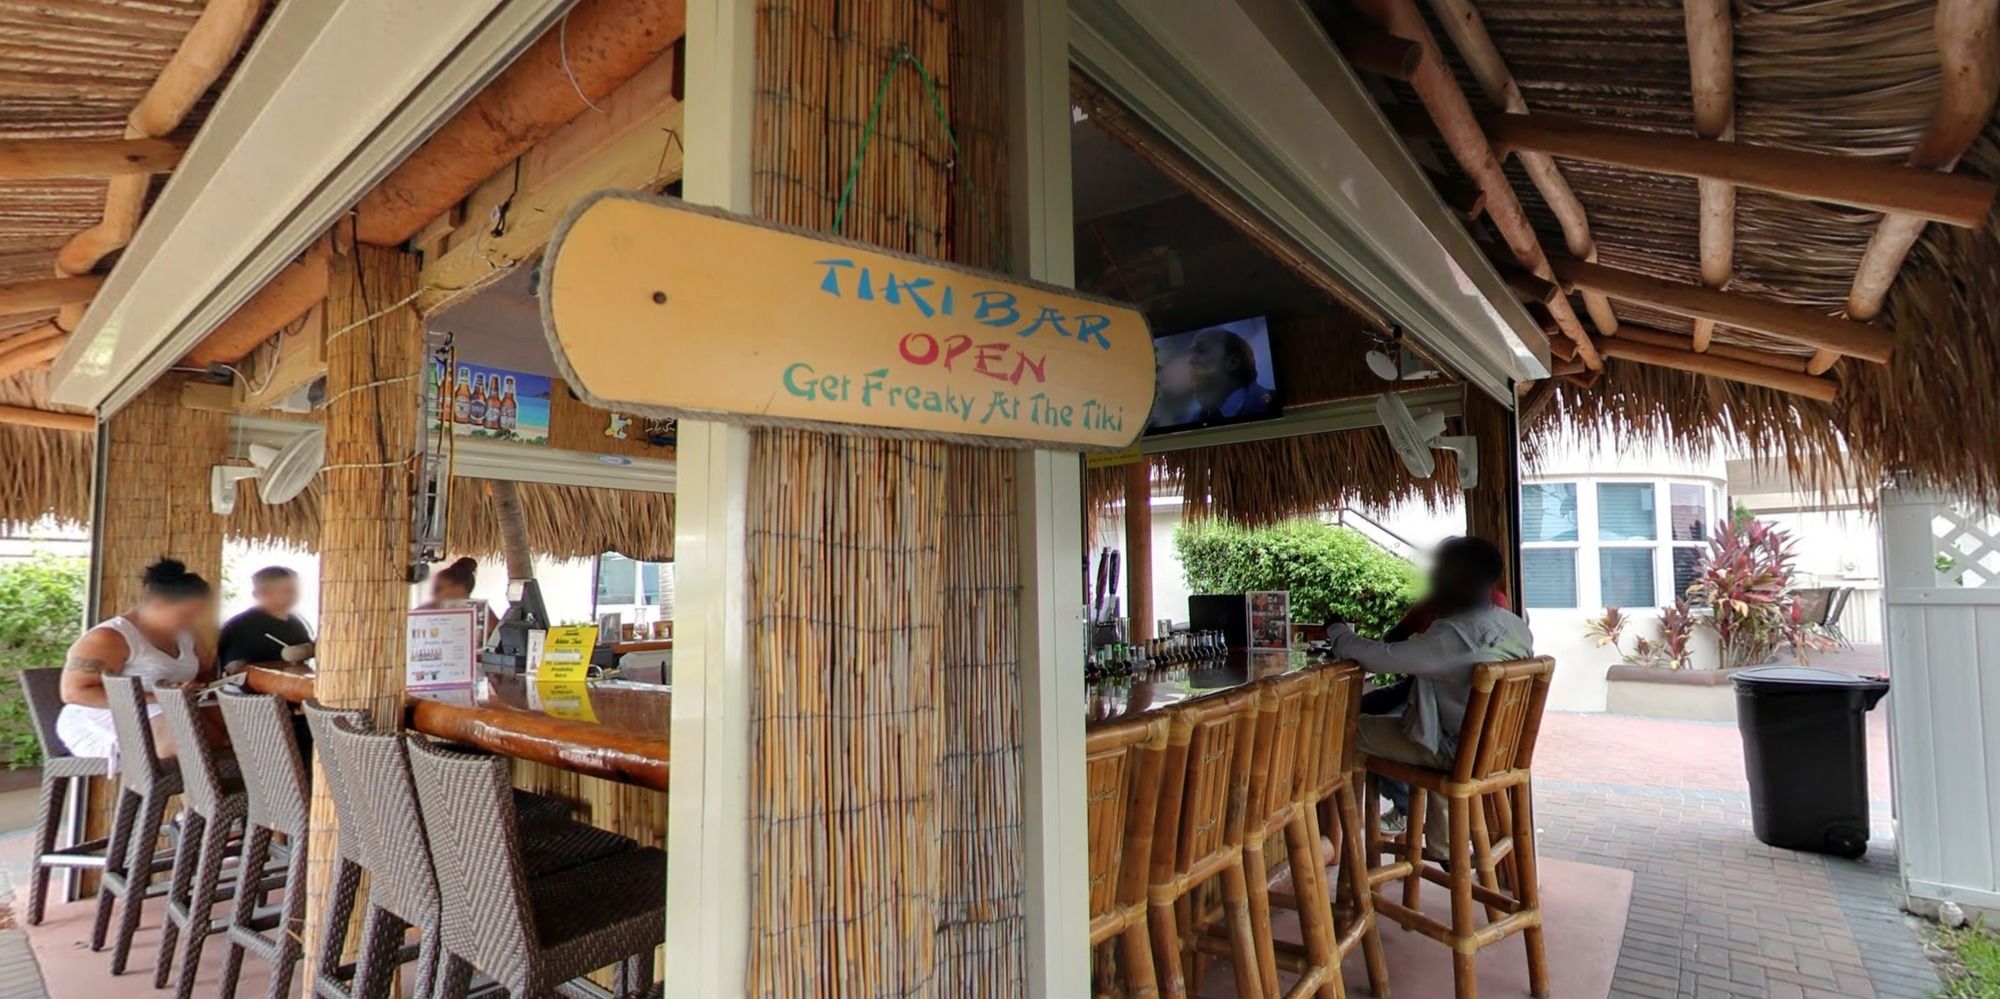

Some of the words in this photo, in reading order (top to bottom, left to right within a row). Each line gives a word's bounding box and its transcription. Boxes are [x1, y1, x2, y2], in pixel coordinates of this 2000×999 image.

[813, 258, 957, 319] TIKI
[971, 290, 1112, 351] BAR
[898, 331, 1048, 386] OPEN
[782, 362, 851, 402] Get
[861, 368, 976, 422] Freaky
[979, 390, 1021, 425] At
[1029, 391, 1074, 428] The
[1081, 399, 1124, 433] Tiki
